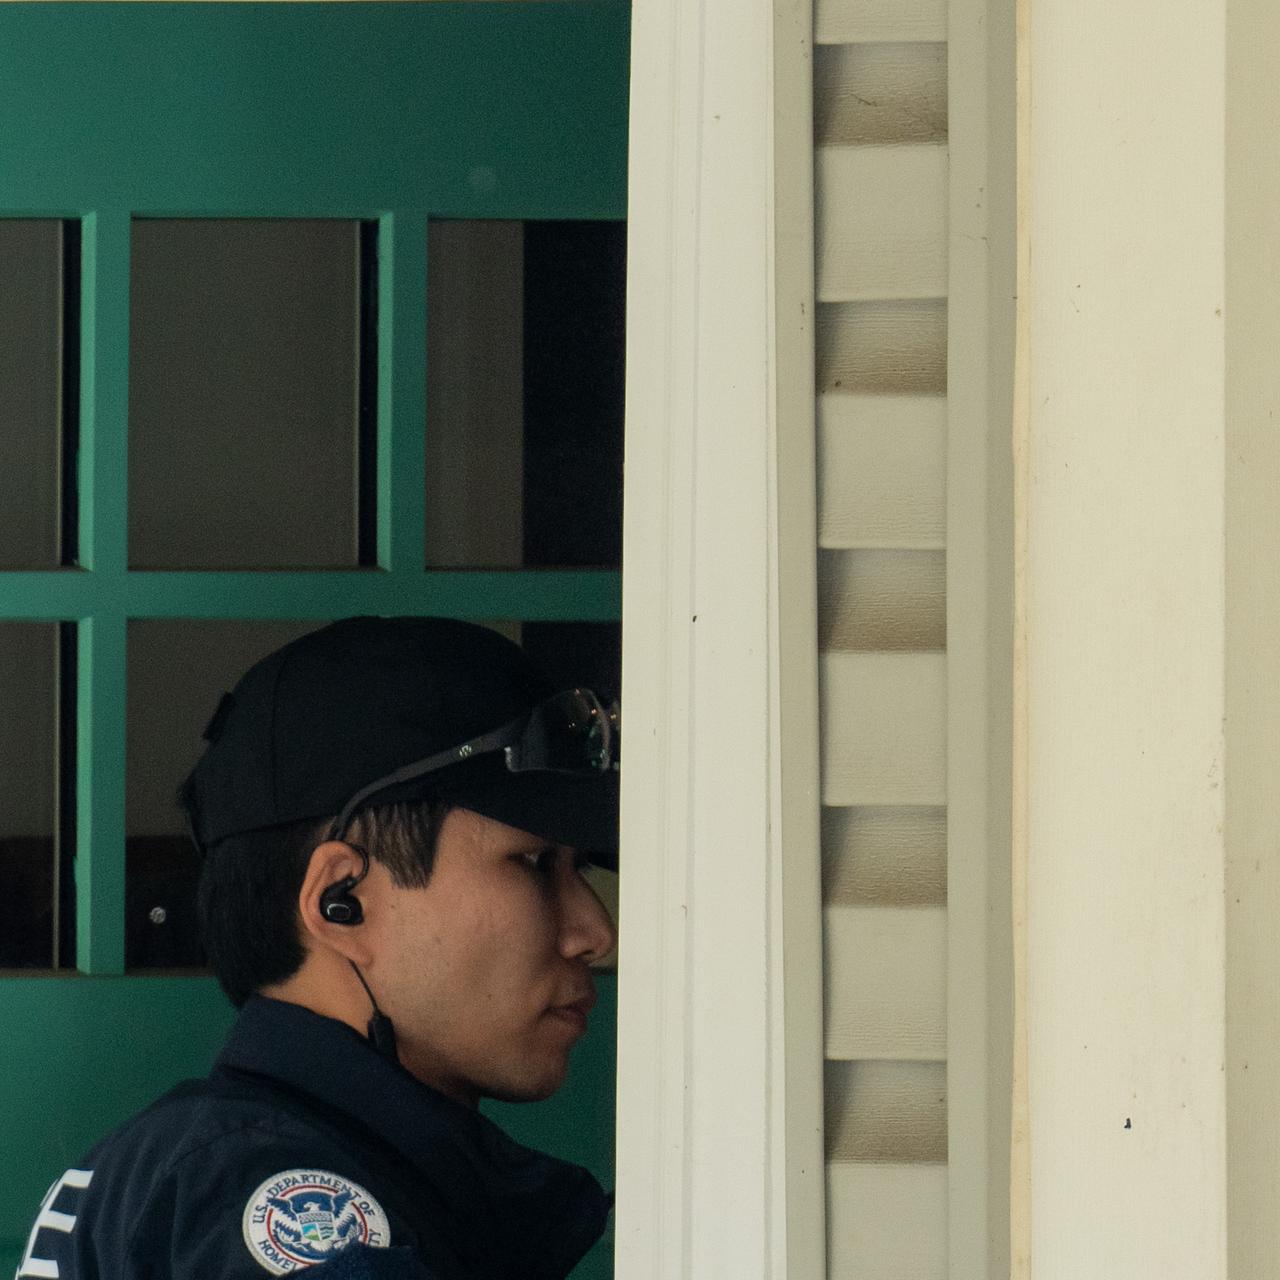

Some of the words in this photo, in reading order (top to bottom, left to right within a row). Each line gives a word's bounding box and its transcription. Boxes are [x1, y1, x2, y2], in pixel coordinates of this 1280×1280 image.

[252, 1203, 269, 1224] U.S.
[267, 1173, 363, 1200] DEPARTMENT
[358, 1200, 376, 1217] OF
